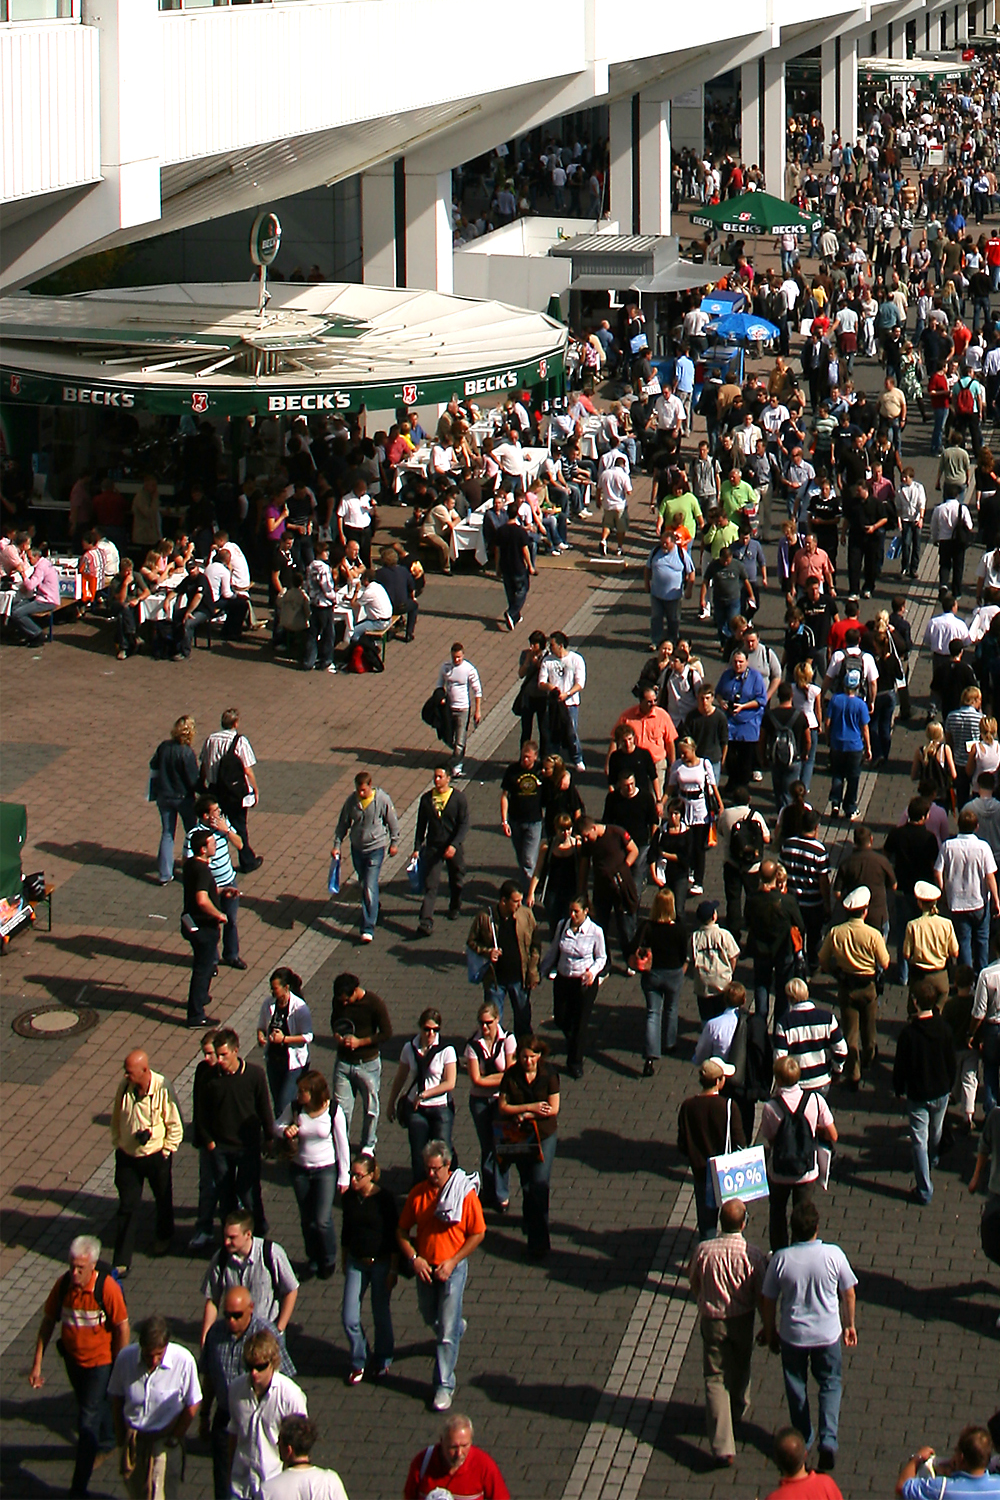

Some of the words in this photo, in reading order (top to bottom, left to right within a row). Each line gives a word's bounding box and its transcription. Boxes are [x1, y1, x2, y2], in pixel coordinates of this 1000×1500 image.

[464, 371, 518, 396] BECK'S
[63, 387, 134, 408] BECK'S
[268, 390, 350, 412] BECK'S
